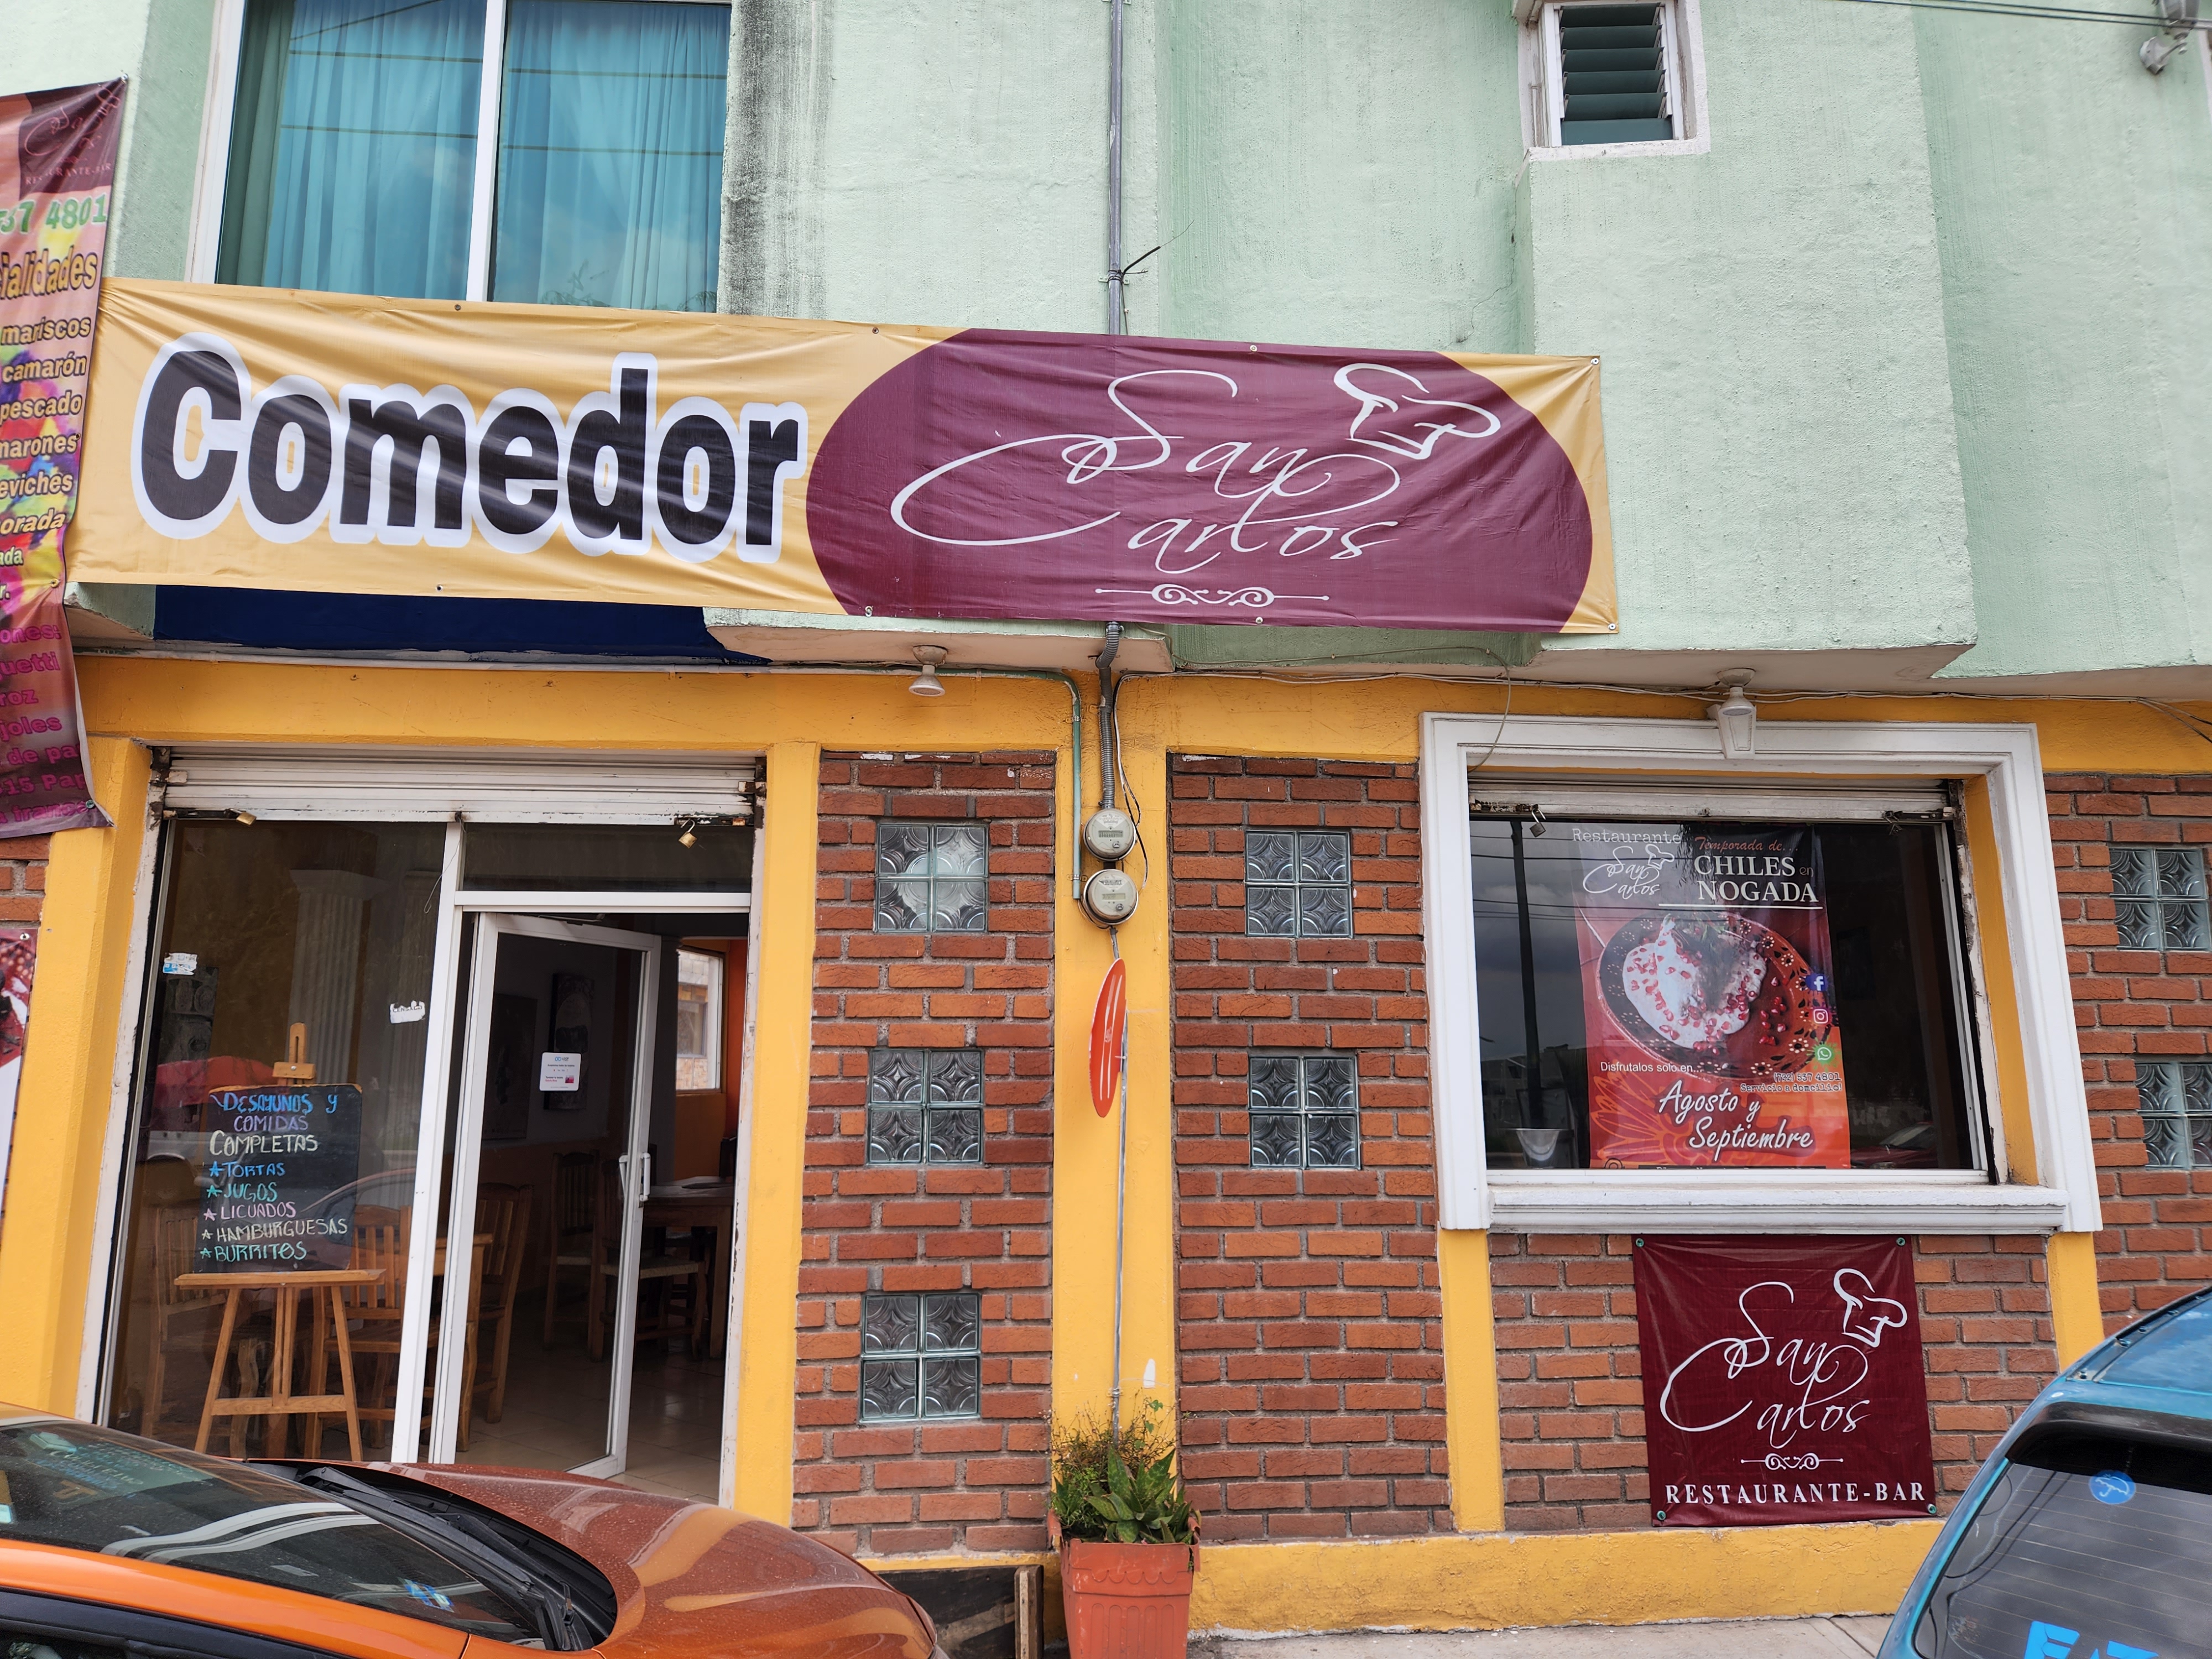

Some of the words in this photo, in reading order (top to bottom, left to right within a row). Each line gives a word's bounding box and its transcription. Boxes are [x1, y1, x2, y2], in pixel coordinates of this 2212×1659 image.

[46, 194, 107, 229] 4801
[0, 244, 98, 300] ialidades
[1, 316, 92, 346] mariscos
[2, 351, 87, 383] camarón
[0, 389, 83, 426] pescado
[1061, 369, 1333, 498] San
[138, 347, 802, 549] Comedor
[890, 433, 1401, 575] Carlos
[0, 507, 66, 535] orada
[0, 651, 61, 676] uetti
[7, 747, 39, 766] de
[45, 744, 81, 764] pa
[1572, 828, 1682, 844] Restaurante
[1694, 836, 1764, 853] Temporada
[1606, 846, 1650, 880] San
[1694, 855, 1796, 877] CHILES
[1799, 867, 1814, 877] en
[1583, 863, 1661, 900] Carlos
[1696, 880, 1819, 902] NOGADA
[1600, 1061, 1653, 1072] Disfrutalos
[1656, 1064, 1677, 1072] solo
[1773, 1072, 1795, 1082] (722)
[1797, 1072, 1813, 1082] 537
[1815, 1072, 1842, 1082] 4801
[1740, 1083, 1783, 1092] Servicio
[1658, 1079, 1739, 1124] Agosto
[1745, 1100, 1761, 1123] y
[233, 1115, 309, 1132] COMIDAS
[209, 1130, 319, 1156] COMPLETAS
[1689, 1115, 1814, 1162] Septiembre
[222, 1161, 286, 1178] TORTAS
[223, 1181, 278, 1202] JUGOS
[220, 1201, 296, 1220] LICUADOS
[216, 1218, 348, 1243] HAMBURGUESAS
[214, 1240, 307, 1262] BURRITOS
[1724, 1281, 1840, 1386] San
[1660, 1337, 1871, 1449] Carlos
[1665, 1482, 1926, 1505] RESTAURANTE-BAR
